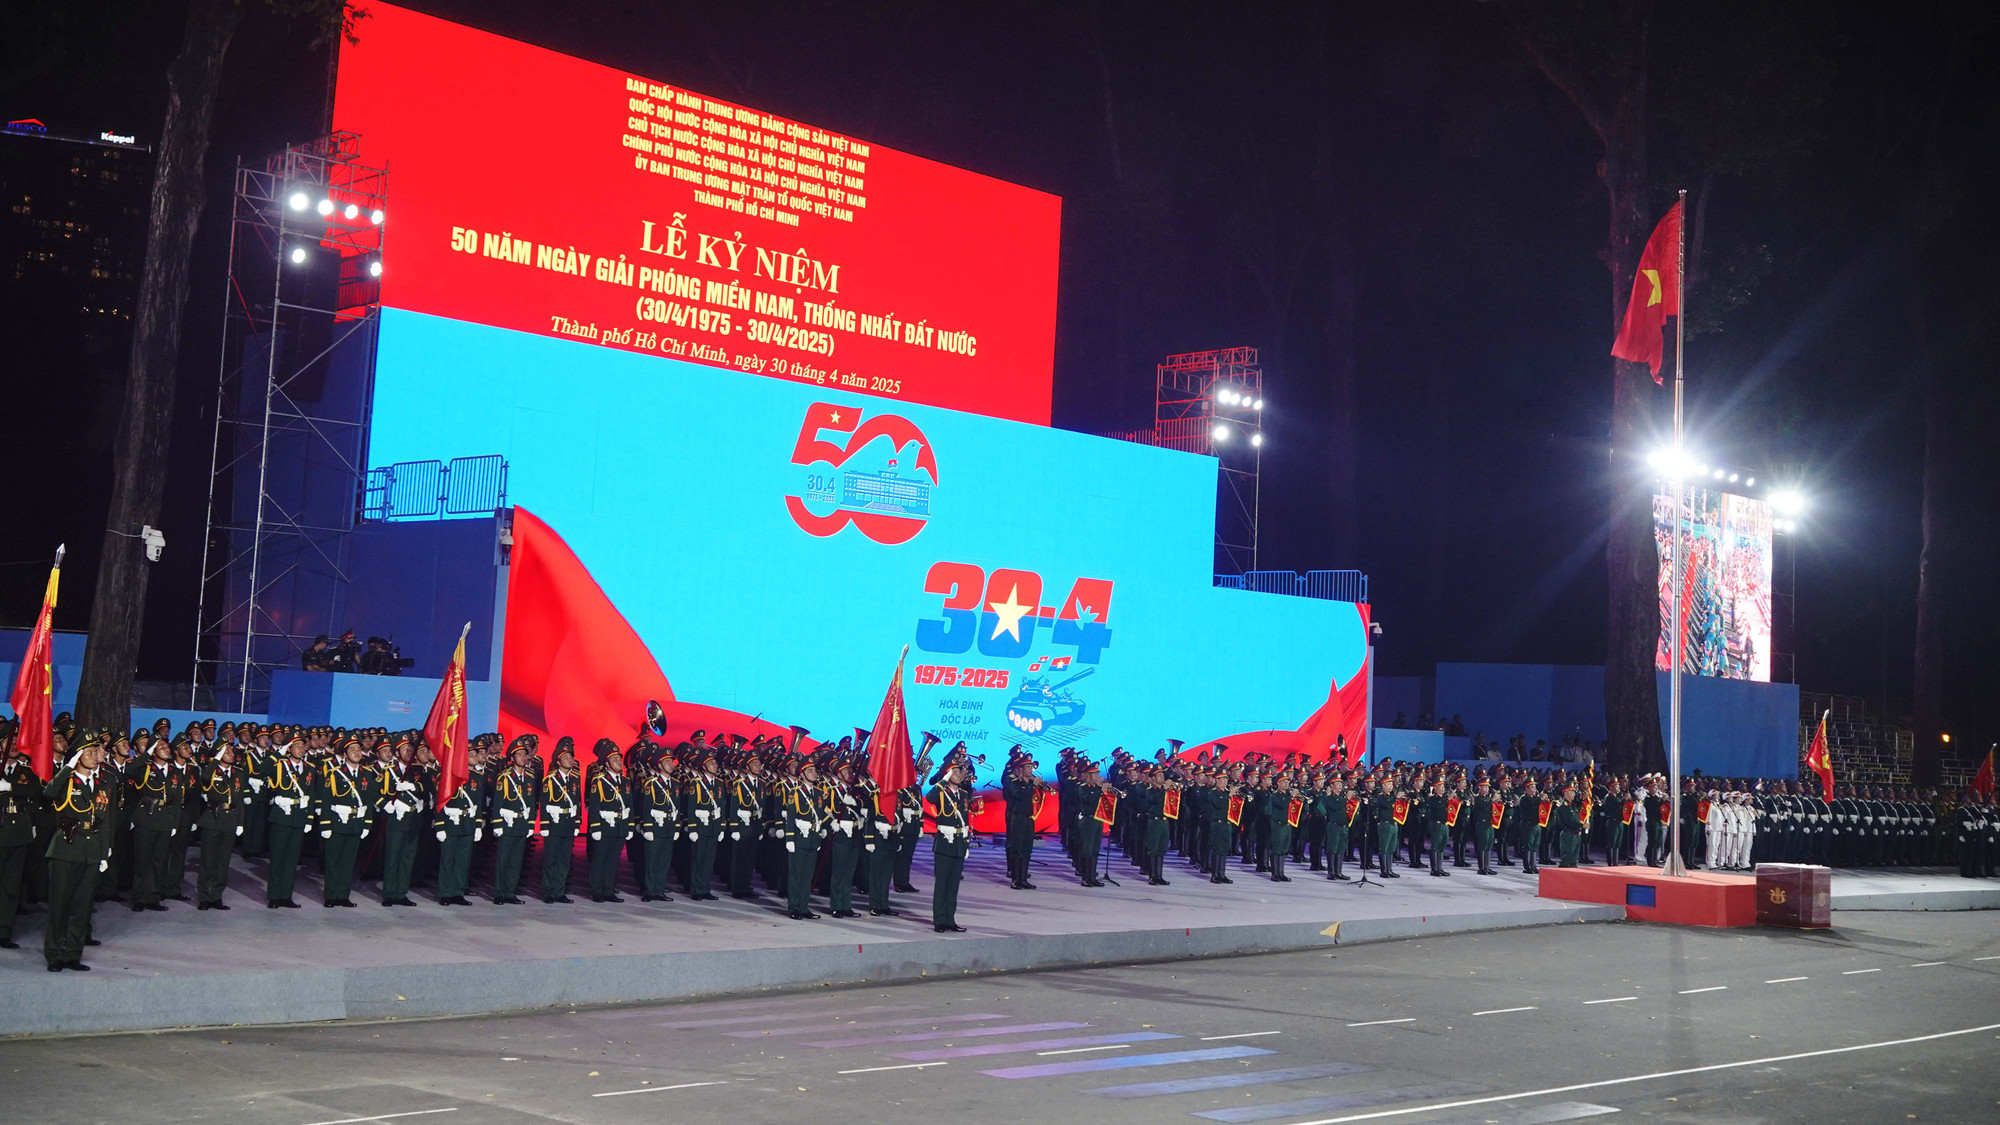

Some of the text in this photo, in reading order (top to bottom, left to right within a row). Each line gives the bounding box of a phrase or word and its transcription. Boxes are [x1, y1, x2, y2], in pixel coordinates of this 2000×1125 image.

[101, 131, 135, 144] Keppel
[626, 78, 869, 157] BAN CHẤP HÀNH TRUNG ƯƠNG ĐẢNG CỘNG SẢN VIỆT NAM
[629, 98, 865, 173] QUỐC HỘI NƯỚC CỘNG HÒA XÃ HỘI CHỦ NGHĨA VIỆT NAM
[623, 134, 866, 208] CHÍNH PHỦ NƯỚC CỘNG HÒA XÃ HỘI CHỦ NGHĨA VIỆT NAM
[628, 117, 863, 190] CHỦ TỊCH NƯỚC CỘNG HÒA XÃ HỘI CHỦ NGHĨA VIỆT NAM
[635, 153, 853, 222] ỦY BAN TRUNG ƯƠNG MẶT TRẬN TỔ QUỐC VIỆT NAM
[694, 190, 799, 226] THÀNH PHỐ HỒ CHÍ MINH
[640, 212, 840, 294] LỄ KỶ NIỆM
[451, 227, 976, 356] 50 NĂM NGÀY GIẢI PHÓNG MIỀN NAM, THỐNG NHẤT ĐẤT NƯỚC
[552, 316, 901, 393] Thành phố Hồ Chí Minh, ngày 30 tháng 4 năm 2025
[636, 296, 730, 335] (30/4/1975
[747, 319, 834, 357] 30/4/2025)
[808, 474, 836, 493] 30.4
[941, 713, 981, 726] ĐỘC LẬP
[961, 699, 984, 710] BÌNH
[964, 729, 989, 740] NHẤT
